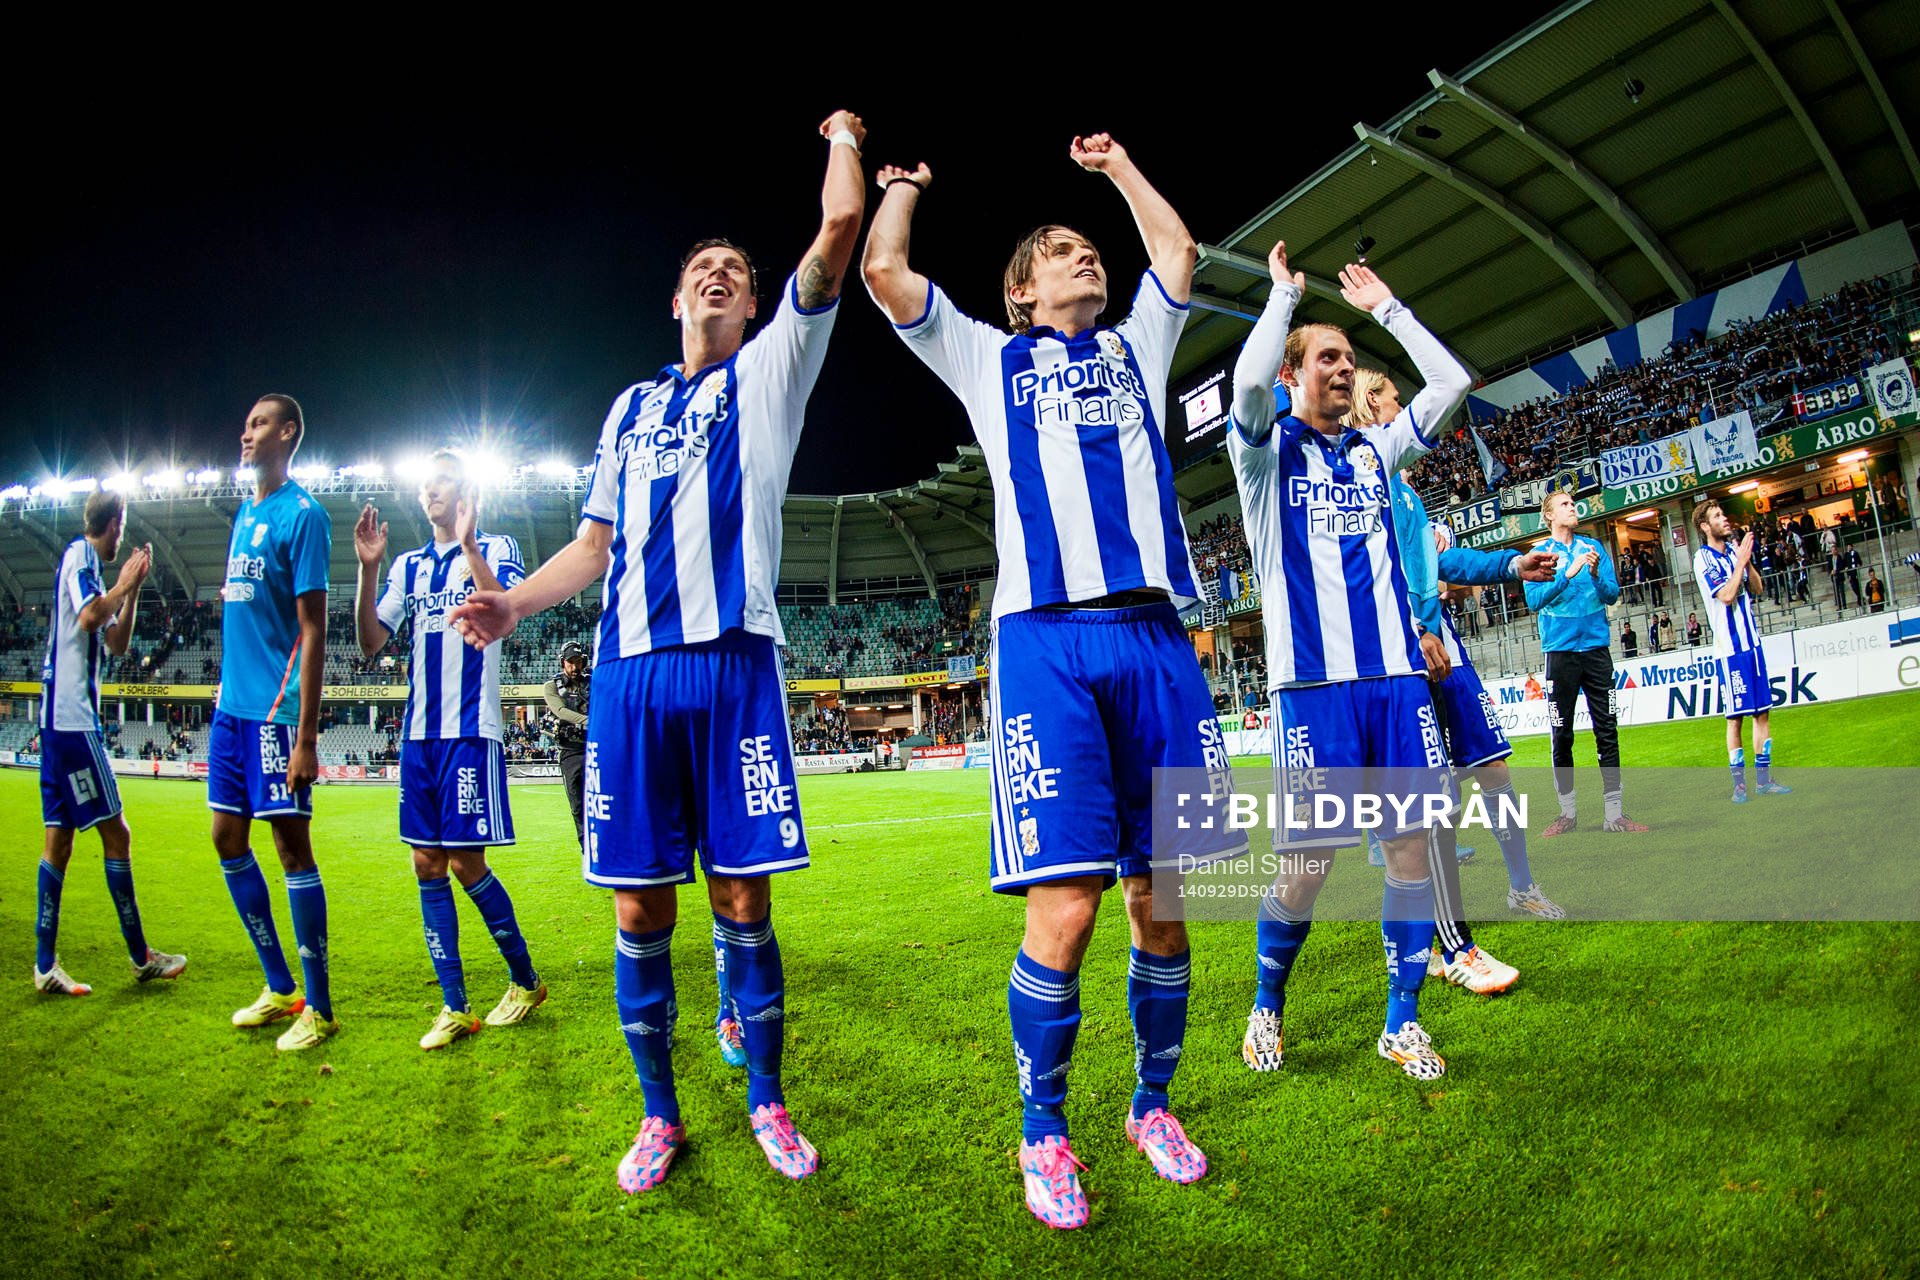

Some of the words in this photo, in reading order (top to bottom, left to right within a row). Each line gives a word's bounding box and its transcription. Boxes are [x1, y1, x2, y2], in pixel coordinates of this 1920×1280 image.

[1015, 356, 1143, 405] Prioritet
[621, 394, 727, 453] Prioitt
[1037, 398, 1141, 425] Finans
[1815, 416, 1876, 450] ÅBRO
[1601, 443, 1660, 465] SEKTION
[1604, 455, 1663, 482] OSLO
[1803, 632, 1881, 660] Imagine.
[126, 685, 169, 696] SOHLBERG
[331, 687, 390, 697] SOHLBERG
[1667, 667, 1818, 720] Nilsk
[260, 725, 276, 742] SE
[1005, 713, 1034, 748] SE
[1198, 718, 1222, 746] SE
[1287, 726, 1310, 750] SE
[261, 742, 280, 758] RN
[739, 735, 772, 764] SE
[1007, 741, 1042, 777] RN
[1288, 747, 1315, 769] RN
[262, 756, 289, 774] EKE
[457, 767, 477, 784] SE
[741, 760, 779, 790] RN
[269, 783, 289, 801] 31
[458, 783, 479, 799] RN
[1010, 767, 1059, 805] EKE
[1289, 769, 1326, 793] EKE
[458, 798, 485, 815] EKE
[745, 784, 793, 817] EKE
[476, 818, 488, 836] 6
[777, 817, 800, 848] 9
[425, 926, 447, 960] SKF
[1014, 1040, 1033, 1096] SKF
